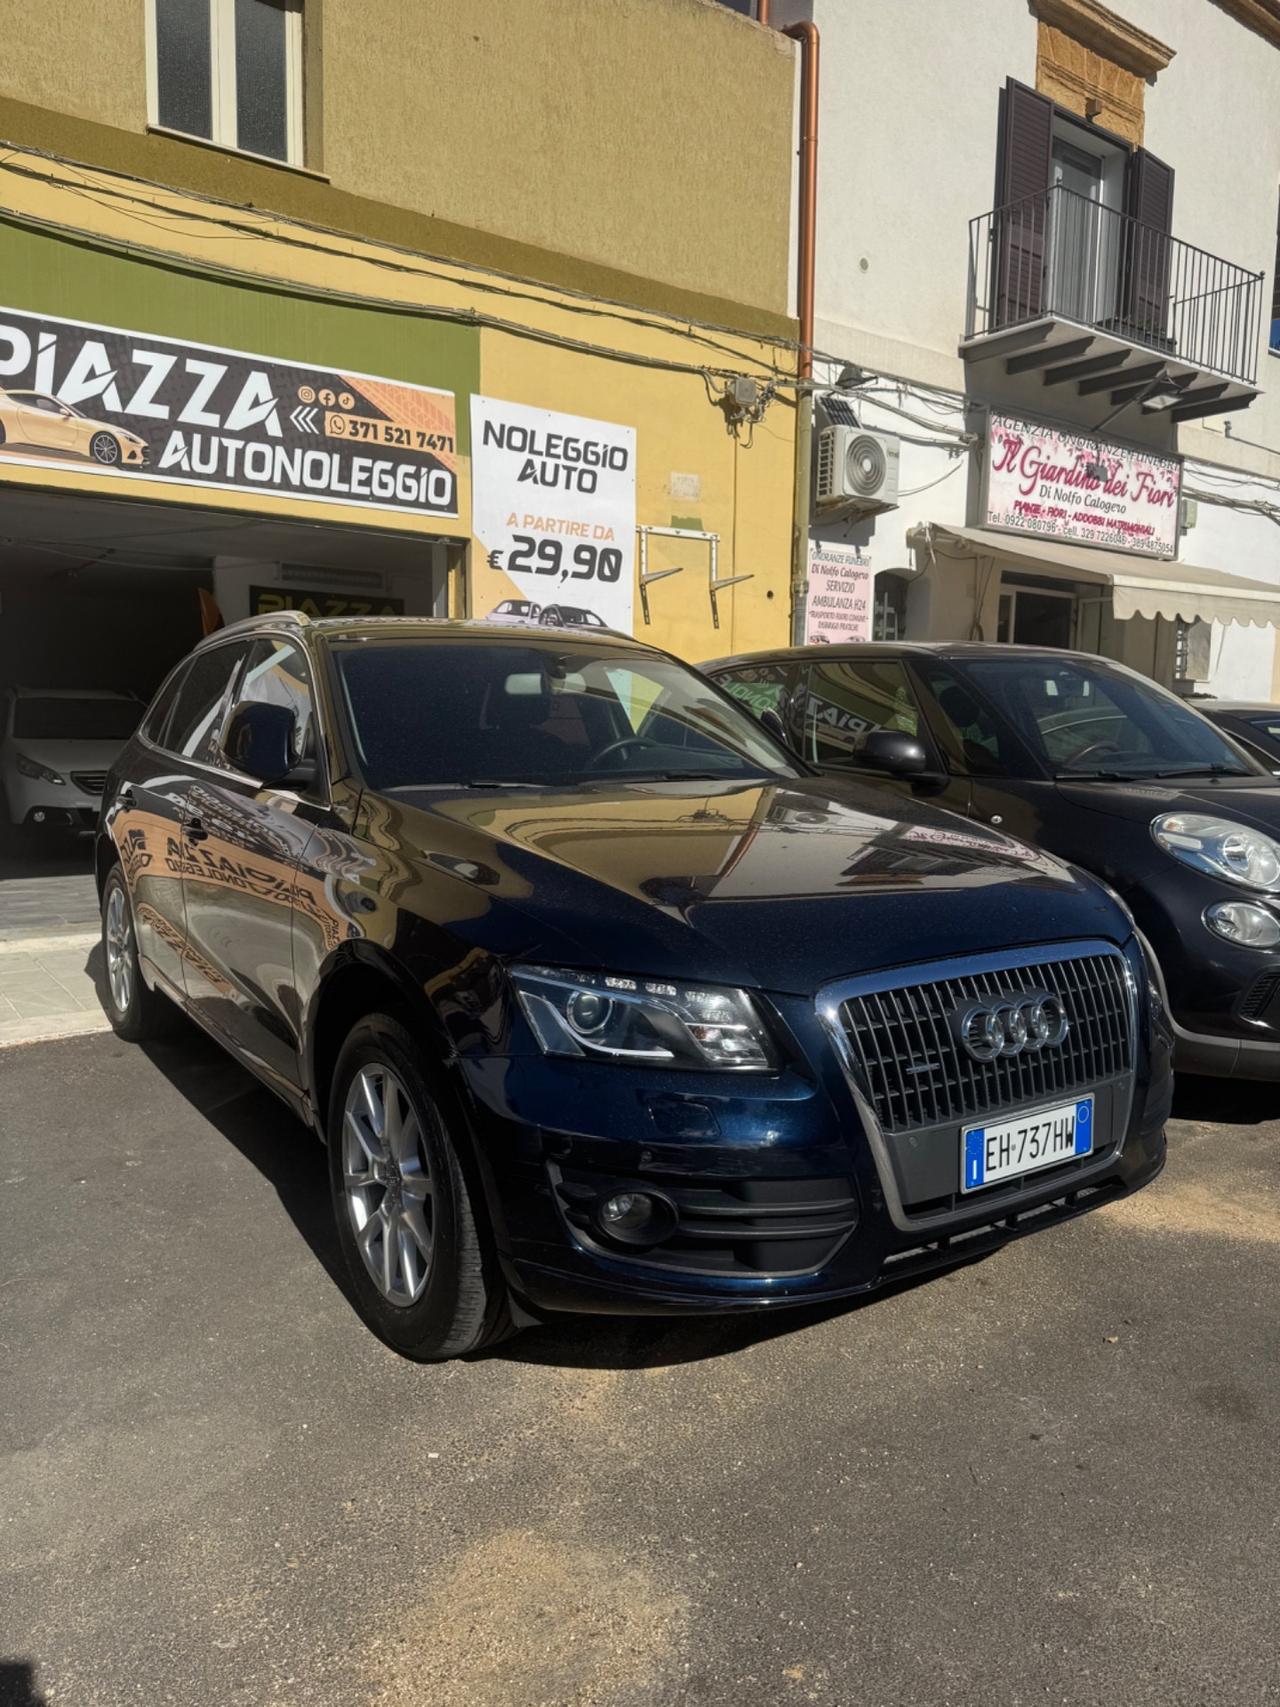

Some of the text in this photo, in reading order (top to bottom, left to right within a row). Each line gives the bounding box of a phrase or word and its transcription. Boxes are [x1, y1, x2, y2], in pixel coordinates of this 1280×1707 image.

[349, 420, 454, 453] 371 521 7471
[991, 416, 1053, 440] AGENZIA
[482, 420, 629, 471] NOLEGGIO
[158, 431, 454, 506] AUTONOLEGGIO
[517, 458, 598, 494] AUTO
[1040, 484, 1127, 514] Di Nolfo Calogero
[1130, 471, 1176, 508] Fiori
[506, 511, 615, 541] A PARTIRE DA
